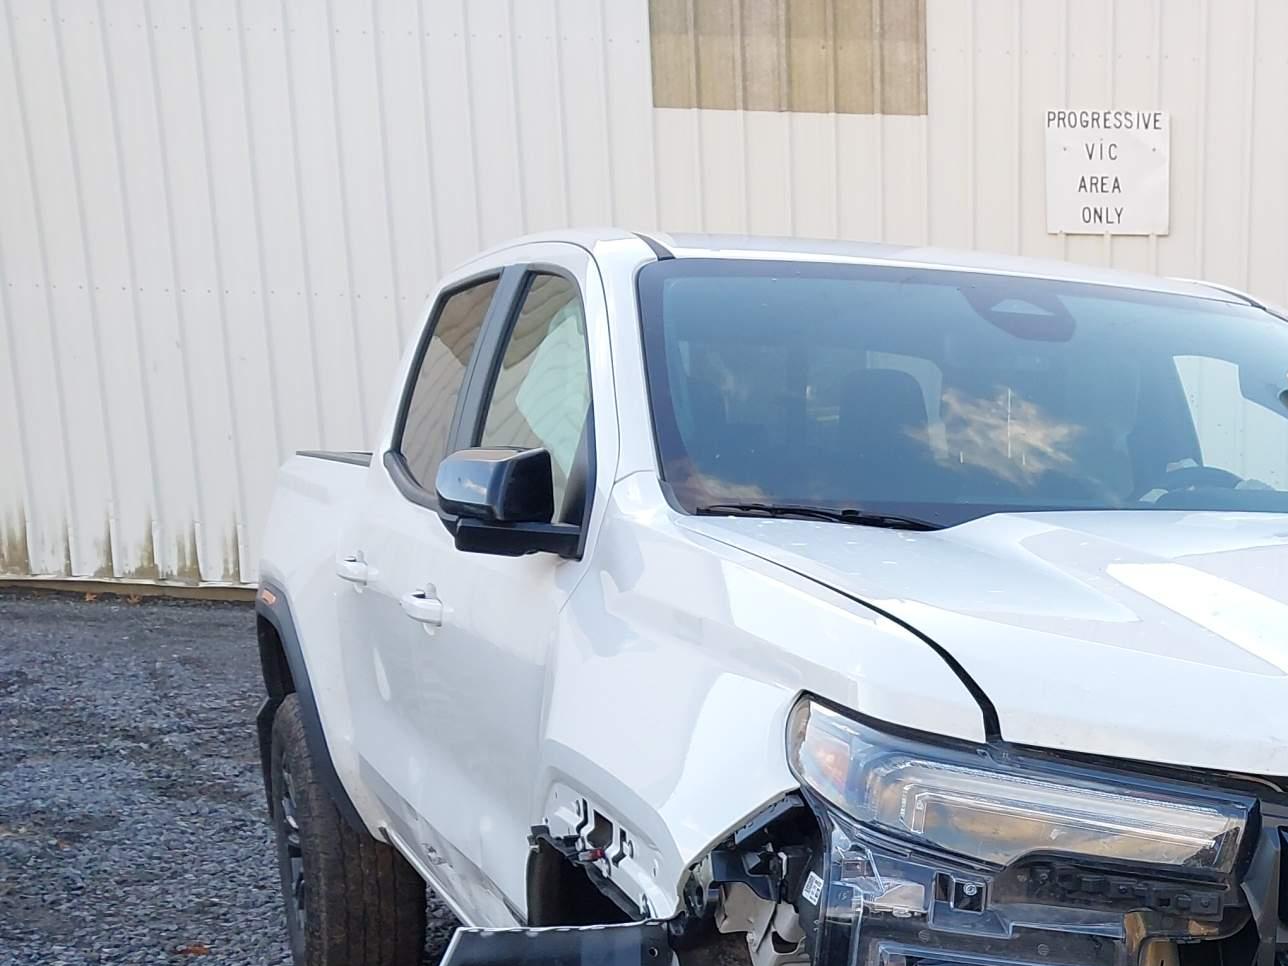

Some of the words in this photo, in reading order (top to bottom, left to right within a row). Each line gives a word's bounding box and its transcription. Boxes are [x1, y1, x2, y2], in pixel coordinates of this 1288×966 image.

[1047, 111, 1162, 129] PROGRESSIVE
[1085, 143, 1118, 160] VIC
[1078, 176, 1121, 193] AREA
[1082, 206, 1124, 224] ONLY
